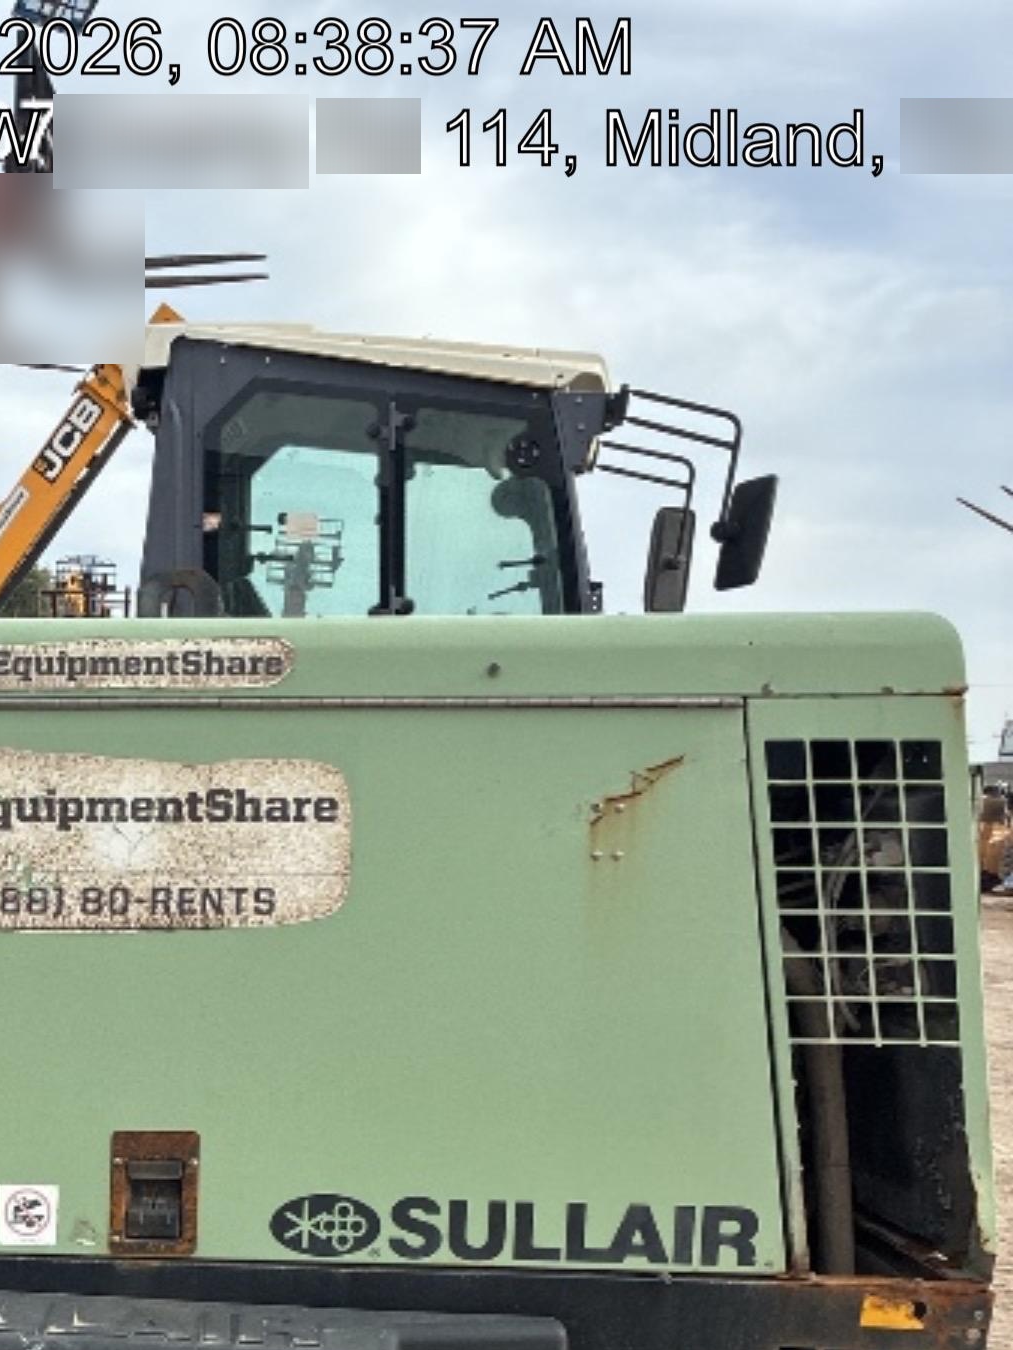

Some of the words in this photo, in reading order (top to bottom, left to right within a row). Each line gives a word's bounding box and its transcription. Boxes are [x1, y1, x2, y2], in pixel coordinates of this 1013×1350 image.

[43, 398, 104, 482] JCB
[78, 885, 278, 918] 80-RENTS
[389, 1194, 760, 1267] SULLAIR
